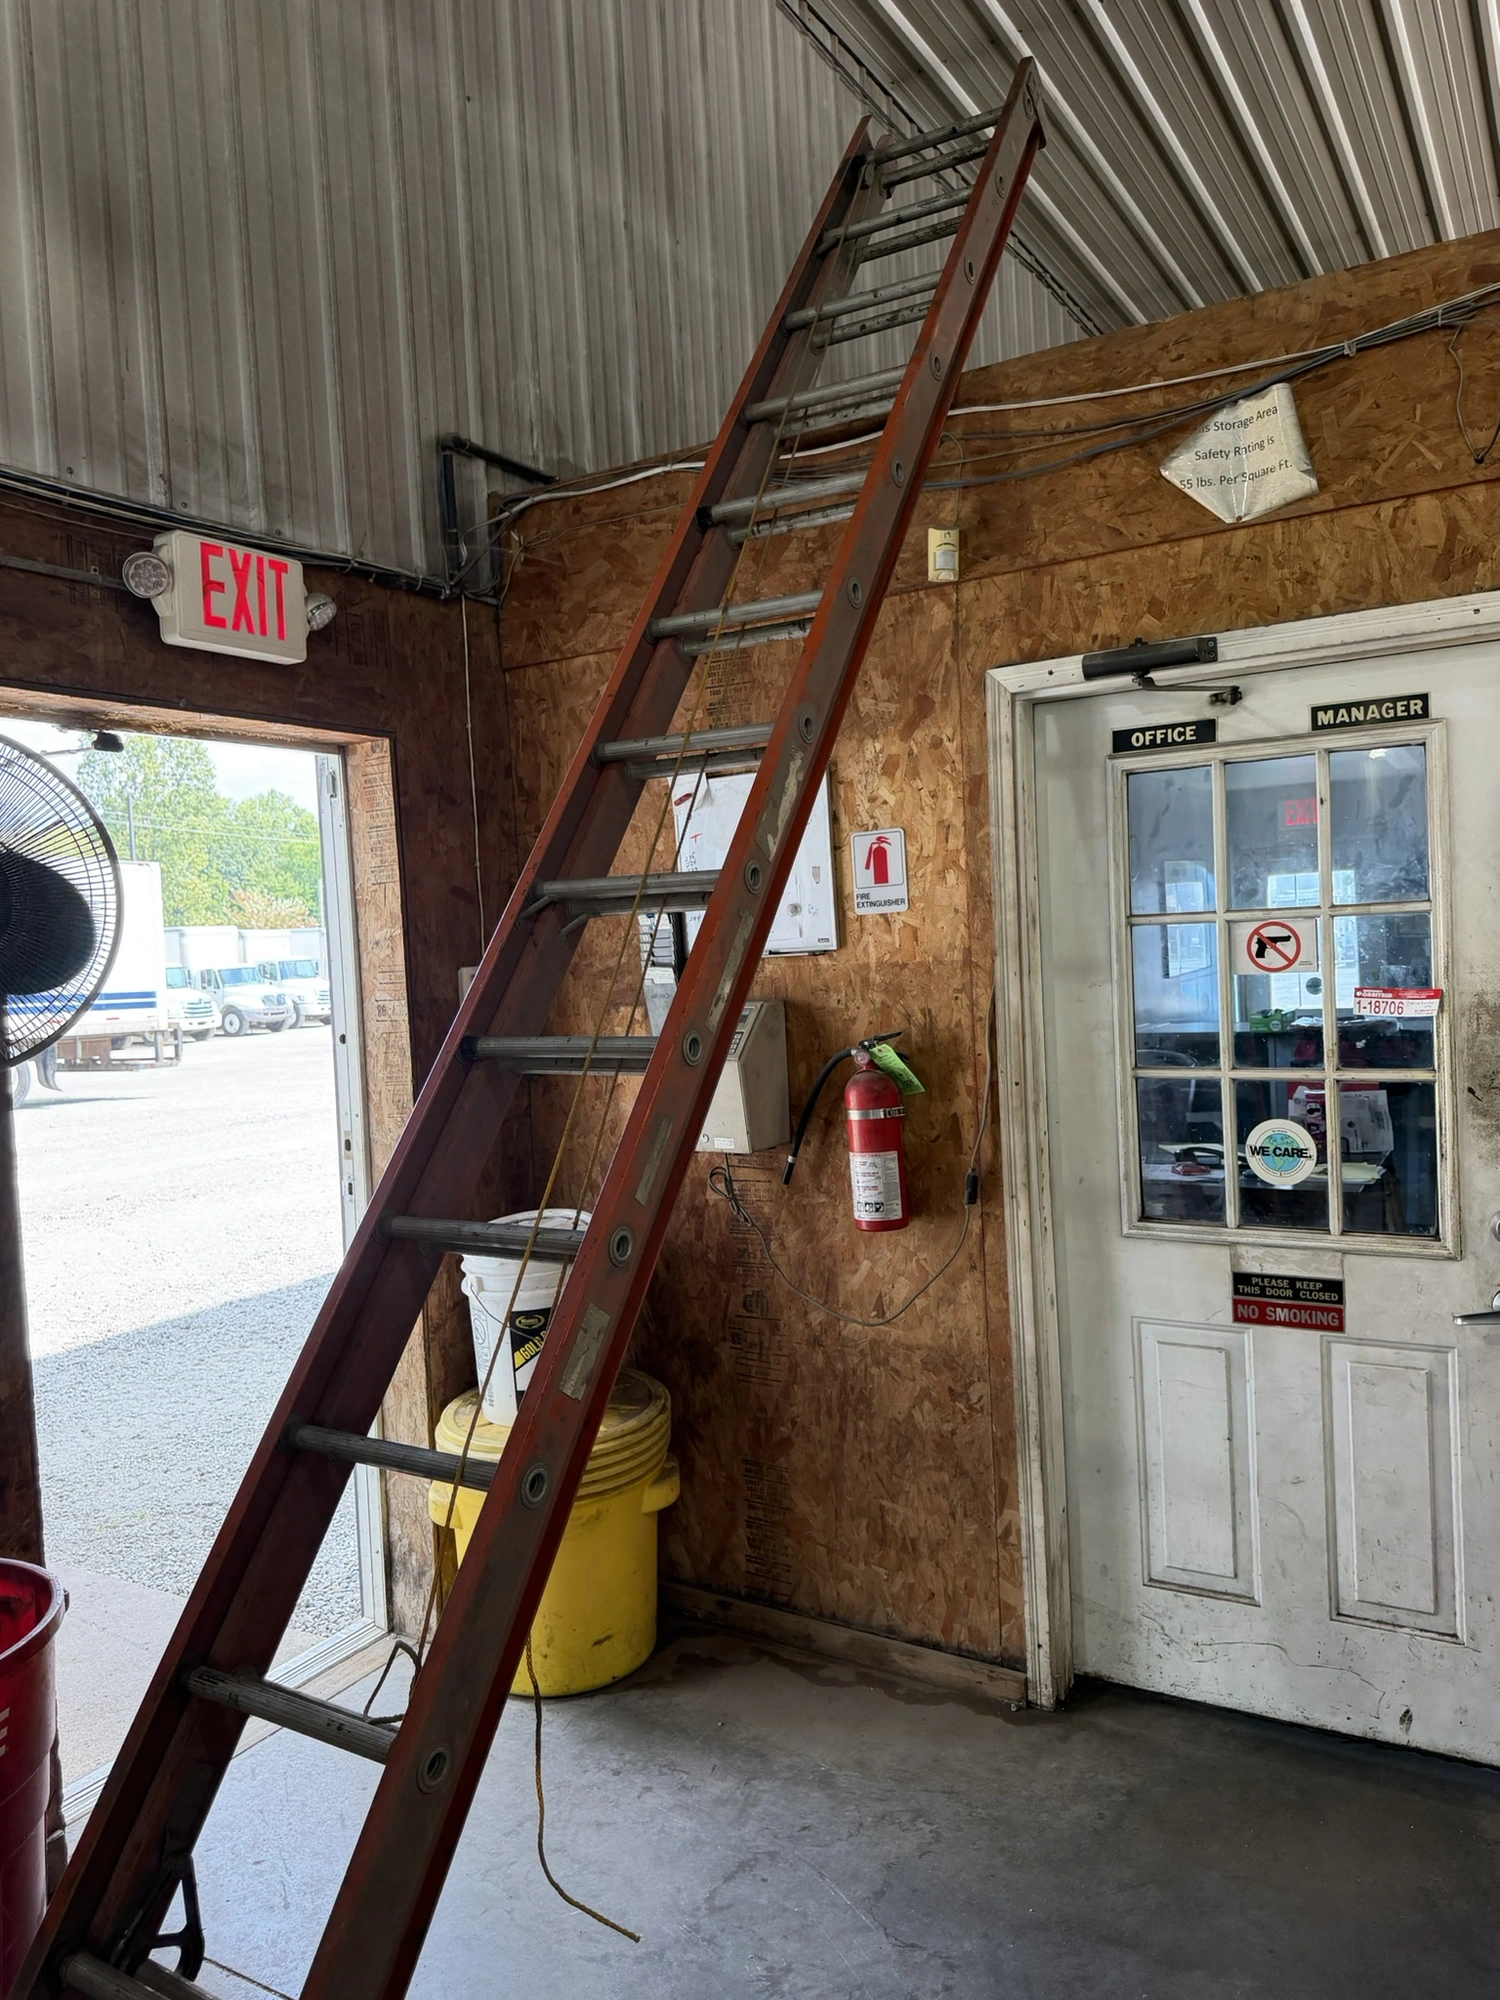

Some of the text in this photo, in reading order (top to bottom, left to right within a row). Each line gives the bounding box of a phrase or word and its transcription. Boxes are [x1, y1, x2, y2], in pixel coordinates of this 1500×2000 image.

[1213, 415, 1254, 432] Storage
[1256, 405, 1278, 420] Area
[1194, 435, 1275, 461] Safety Rating is
[1196, 477, 1216, 488] lbs.
[1219, 475, 1239, 486] Per
[1241, 465, 1276, 483] Square
[1278, 458, 1293, 471] Ft.
[200, 541, 289, 641] EXIT
[1316, 699, 1424, 726] MANAGER
[1131, 726, 1197, 748] OFFICE
[856, 892, 871, 900] FIRE
[856, 898, 906, 909] EXTINGUISHER
[1356, 1000, 1405, 1015] 1-18706
[1249, 1145, 1312, 1159] WE CARE.
[1237, 1285, 1339, 1301] THIS DOOR CLOSED
[1252, 1277, 1323, 1290] PLEASE KEEP
[1237, 1304, 1339, 1326] NO SMOKING
